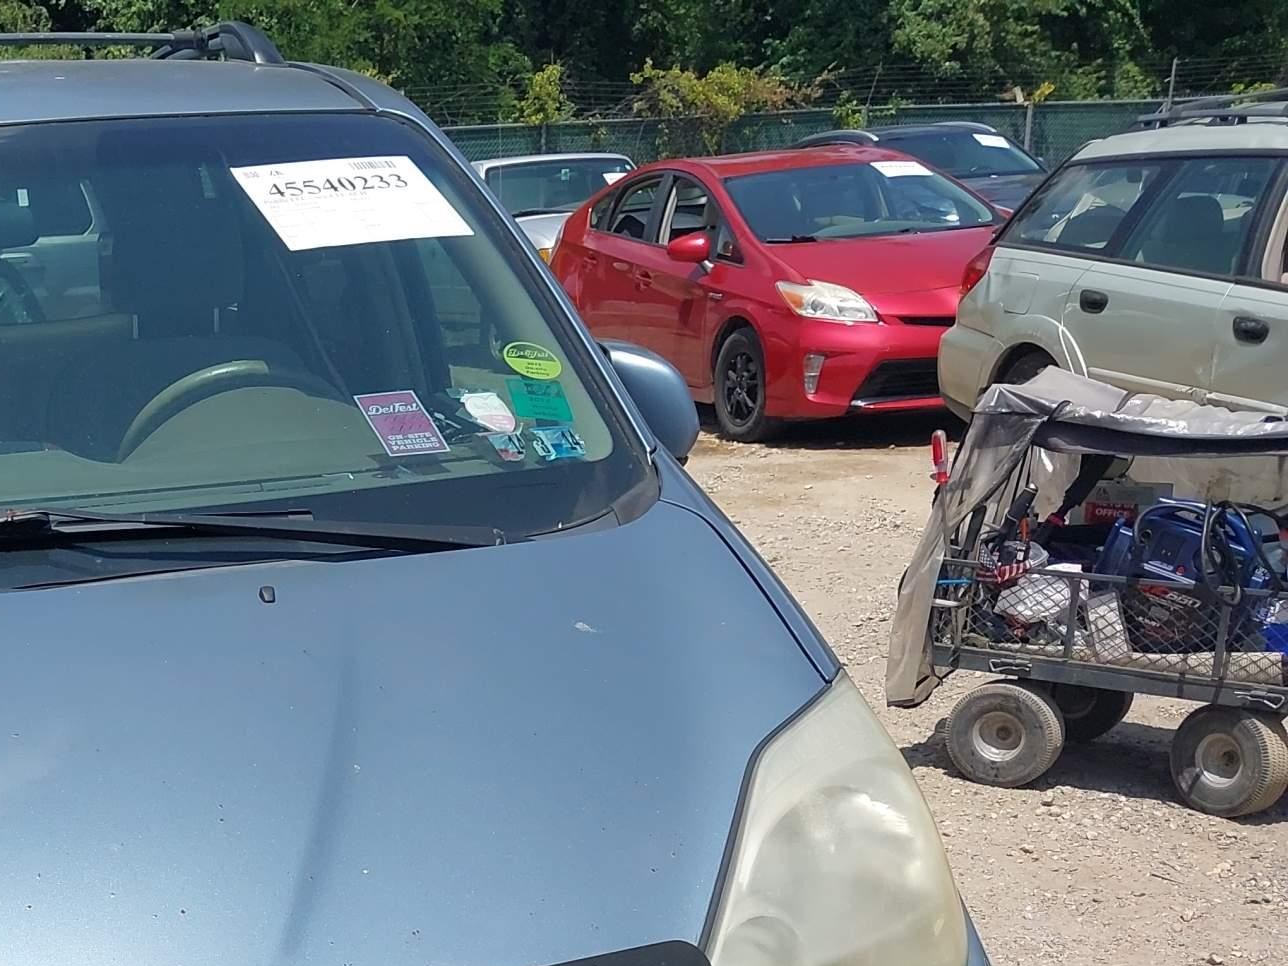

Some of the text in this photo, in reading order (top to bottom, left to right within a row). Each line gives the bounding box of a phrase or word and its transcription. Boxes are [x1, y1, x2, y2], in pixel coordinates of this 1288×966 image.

[269, 174, 408, 198] 45540233
[368, 402, 420, 416] DelFest
[387, 431, 433, 441] ON-SITE
[388, 436, 438, 446] VEHICLE
[391, 442, 440, 451] PARKING
[1095, 507, 1130, 517] OFFICE
